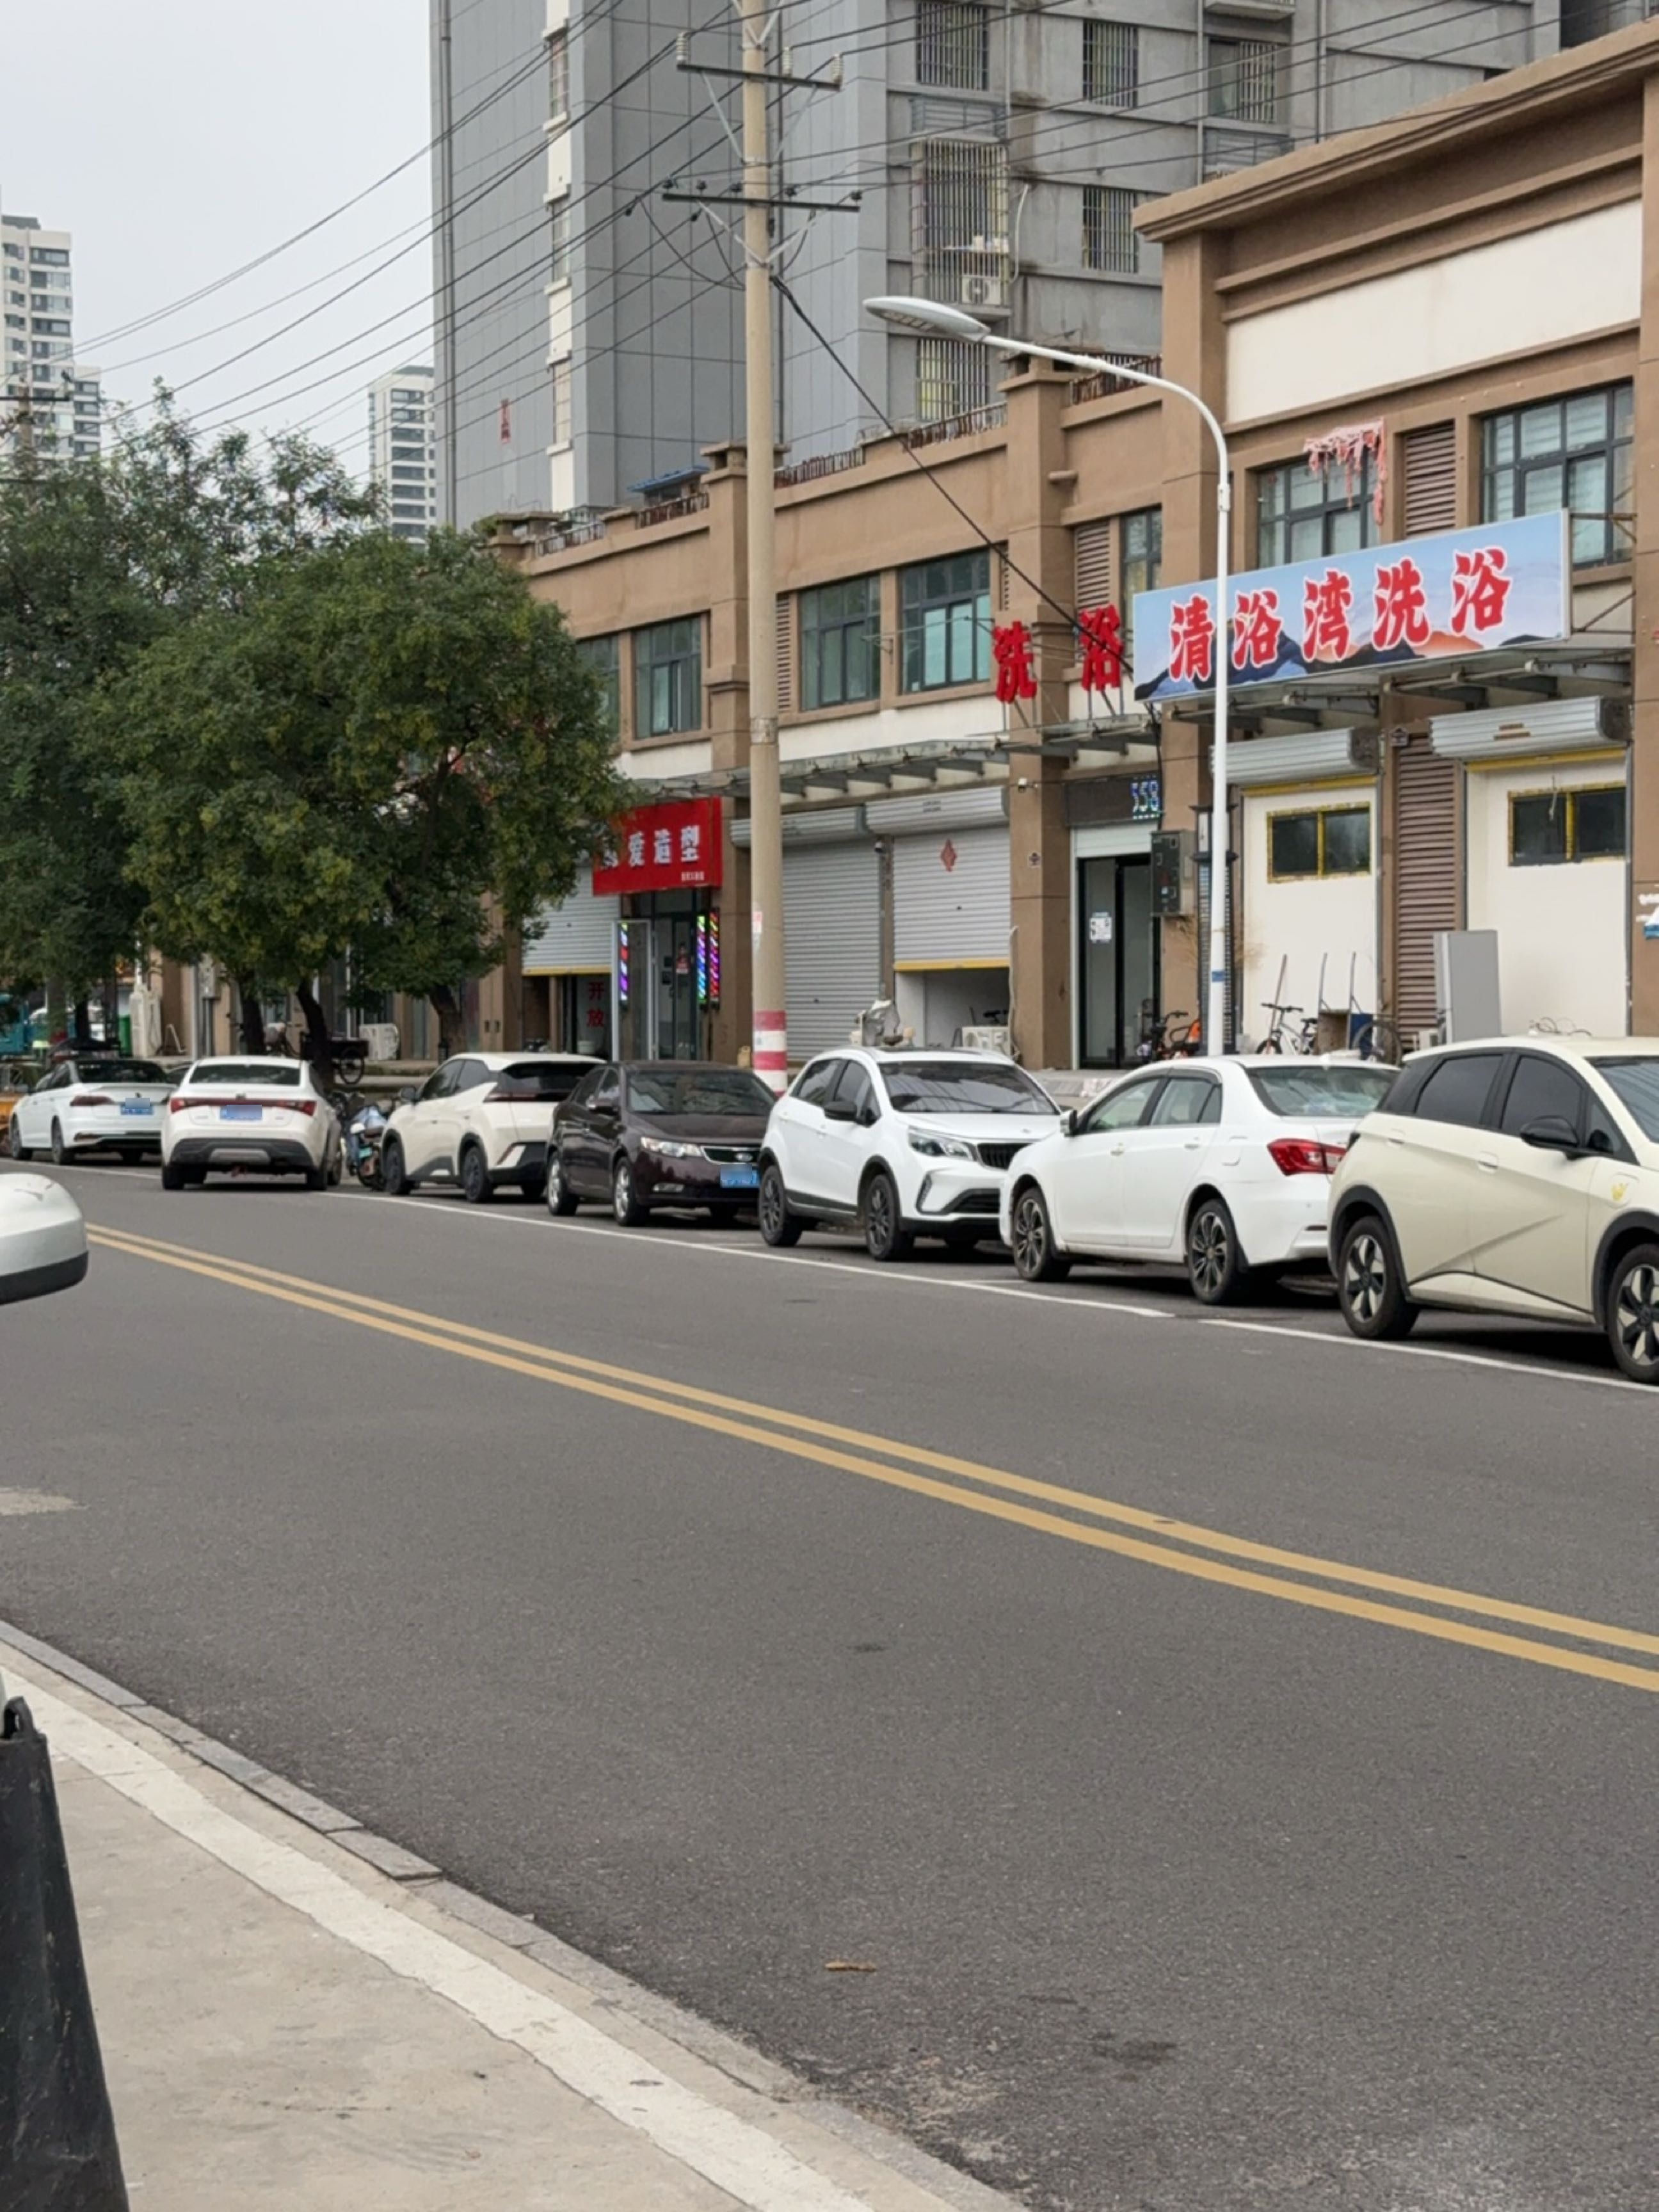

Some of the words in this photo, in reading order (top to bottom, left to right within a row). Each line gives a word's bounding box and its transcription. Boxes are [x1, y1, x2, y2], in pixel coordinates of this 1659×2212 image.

[993, 604, 1123, 703] 洗浴
[1169, 545, 1511, 682] 清浴湾洗浴
